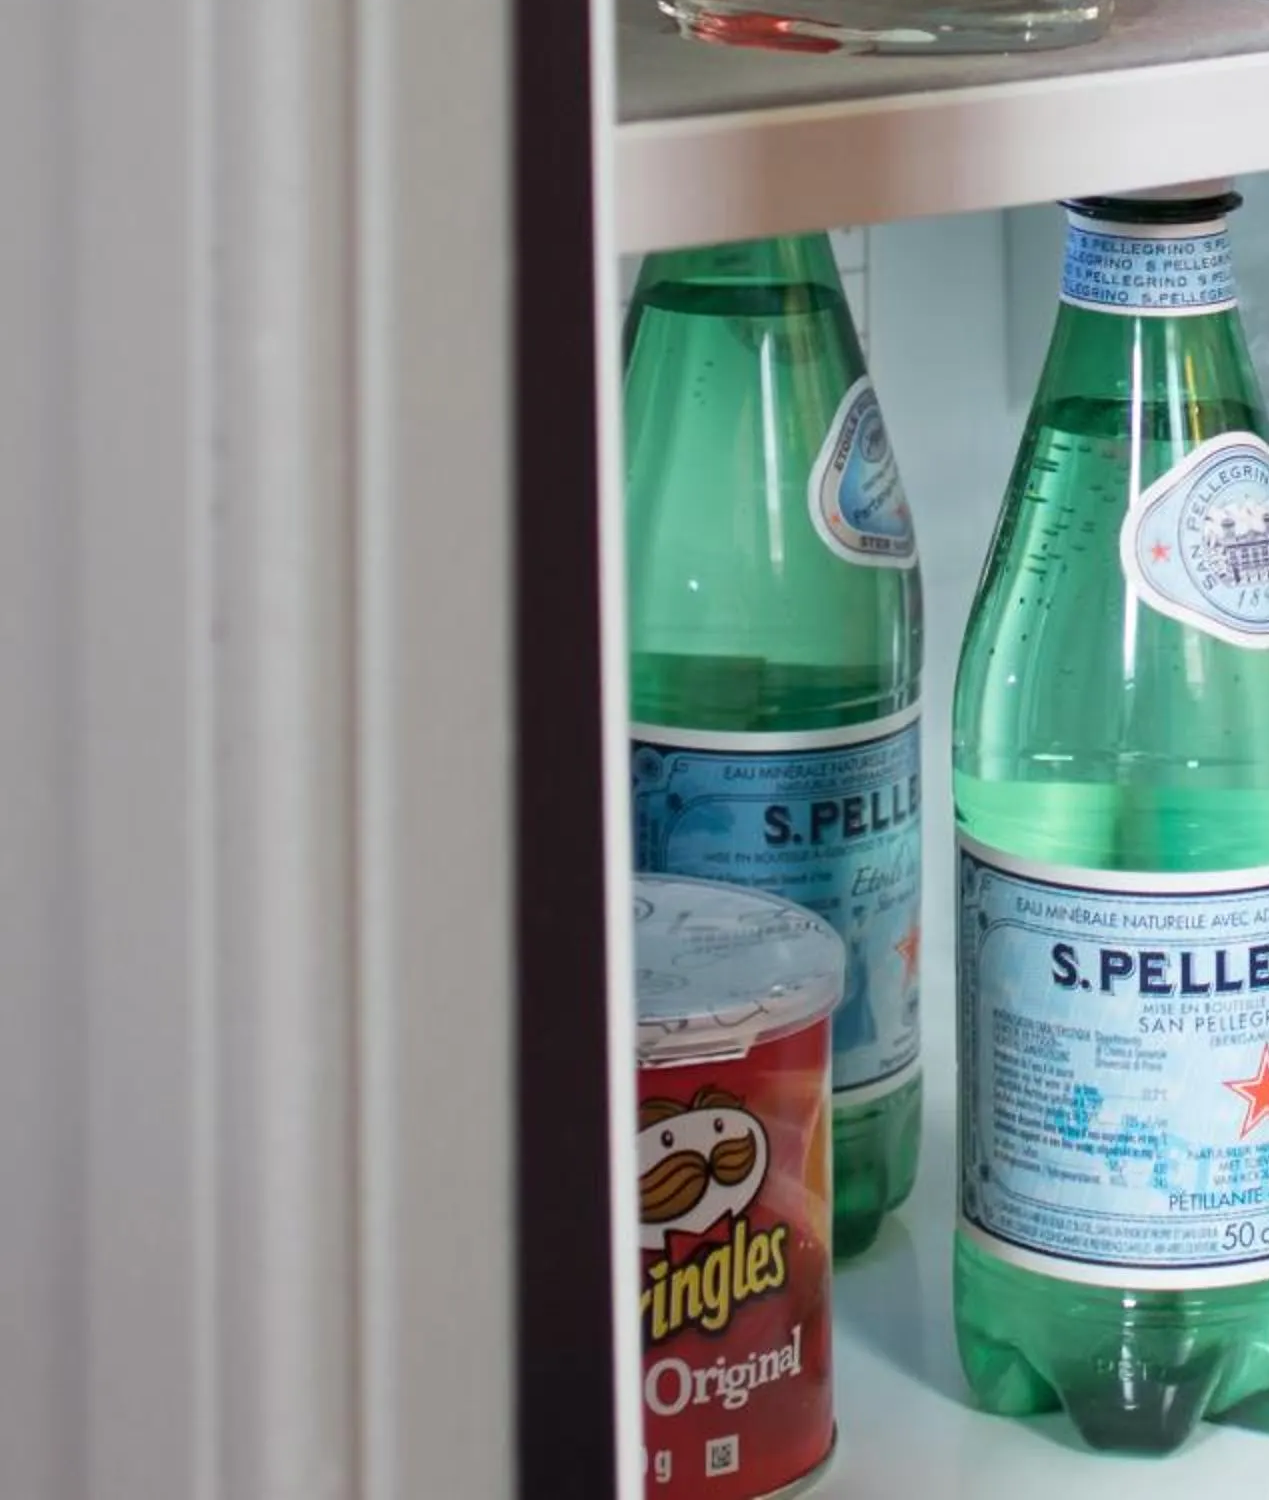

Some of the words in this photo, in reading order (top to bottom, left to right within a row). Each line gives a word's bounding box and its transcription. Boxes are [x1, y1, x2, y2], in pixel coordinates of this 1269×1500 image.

[1191, 543, 1218, 591] SAN
[723, 764, 754, 780] EAU
[1016, 897, 1043, 917] EAU
[1044, 902, 1118, 928] MINÉRALE
[1123, 914, 1206, 931] NATURELLE
[1211, 911, 1249, 928] AVEC
[1142, 1002, 1174, 1015] MISE
[1180, 1002, 1200, 1015] EN
[1138, 1017, 1184, 1034] SAN
[1169, 1186, 1264, 1212] PÉTILLANTE
[1221, 1221, 1255, 1251] 50
[646, 1324, 802, 1416] Original
